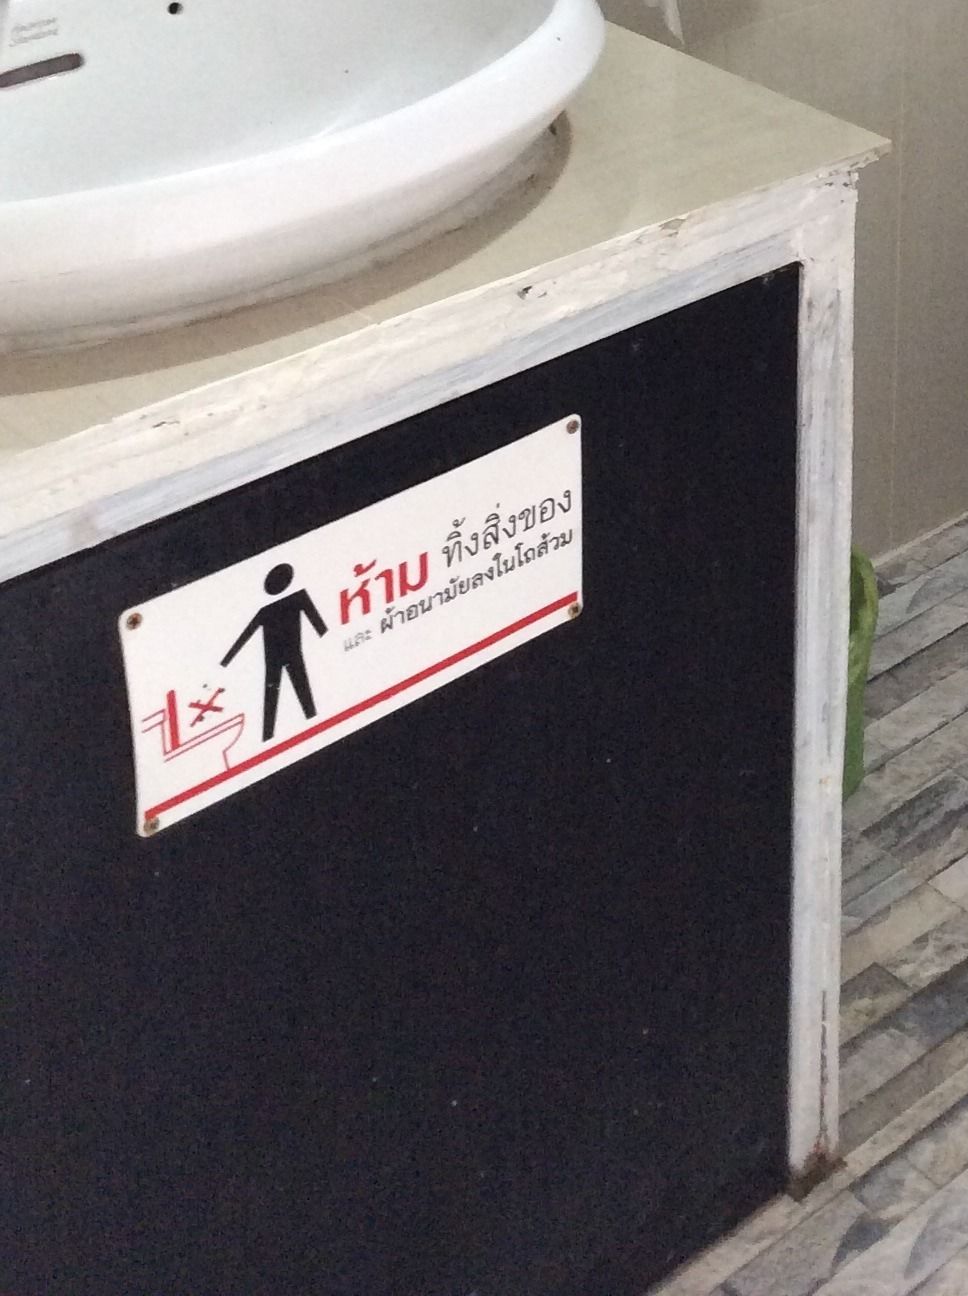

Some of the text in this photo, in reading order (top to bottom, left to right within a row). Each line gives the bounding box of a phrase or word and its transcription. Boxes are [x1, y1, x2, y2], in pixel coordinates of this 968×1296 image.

[339, 489, 573, 626] ห้าม ทิ้งสิ่งของ
[343, 528, 574, 652] และ ผ้าอนามัยลงในโถส้วม
